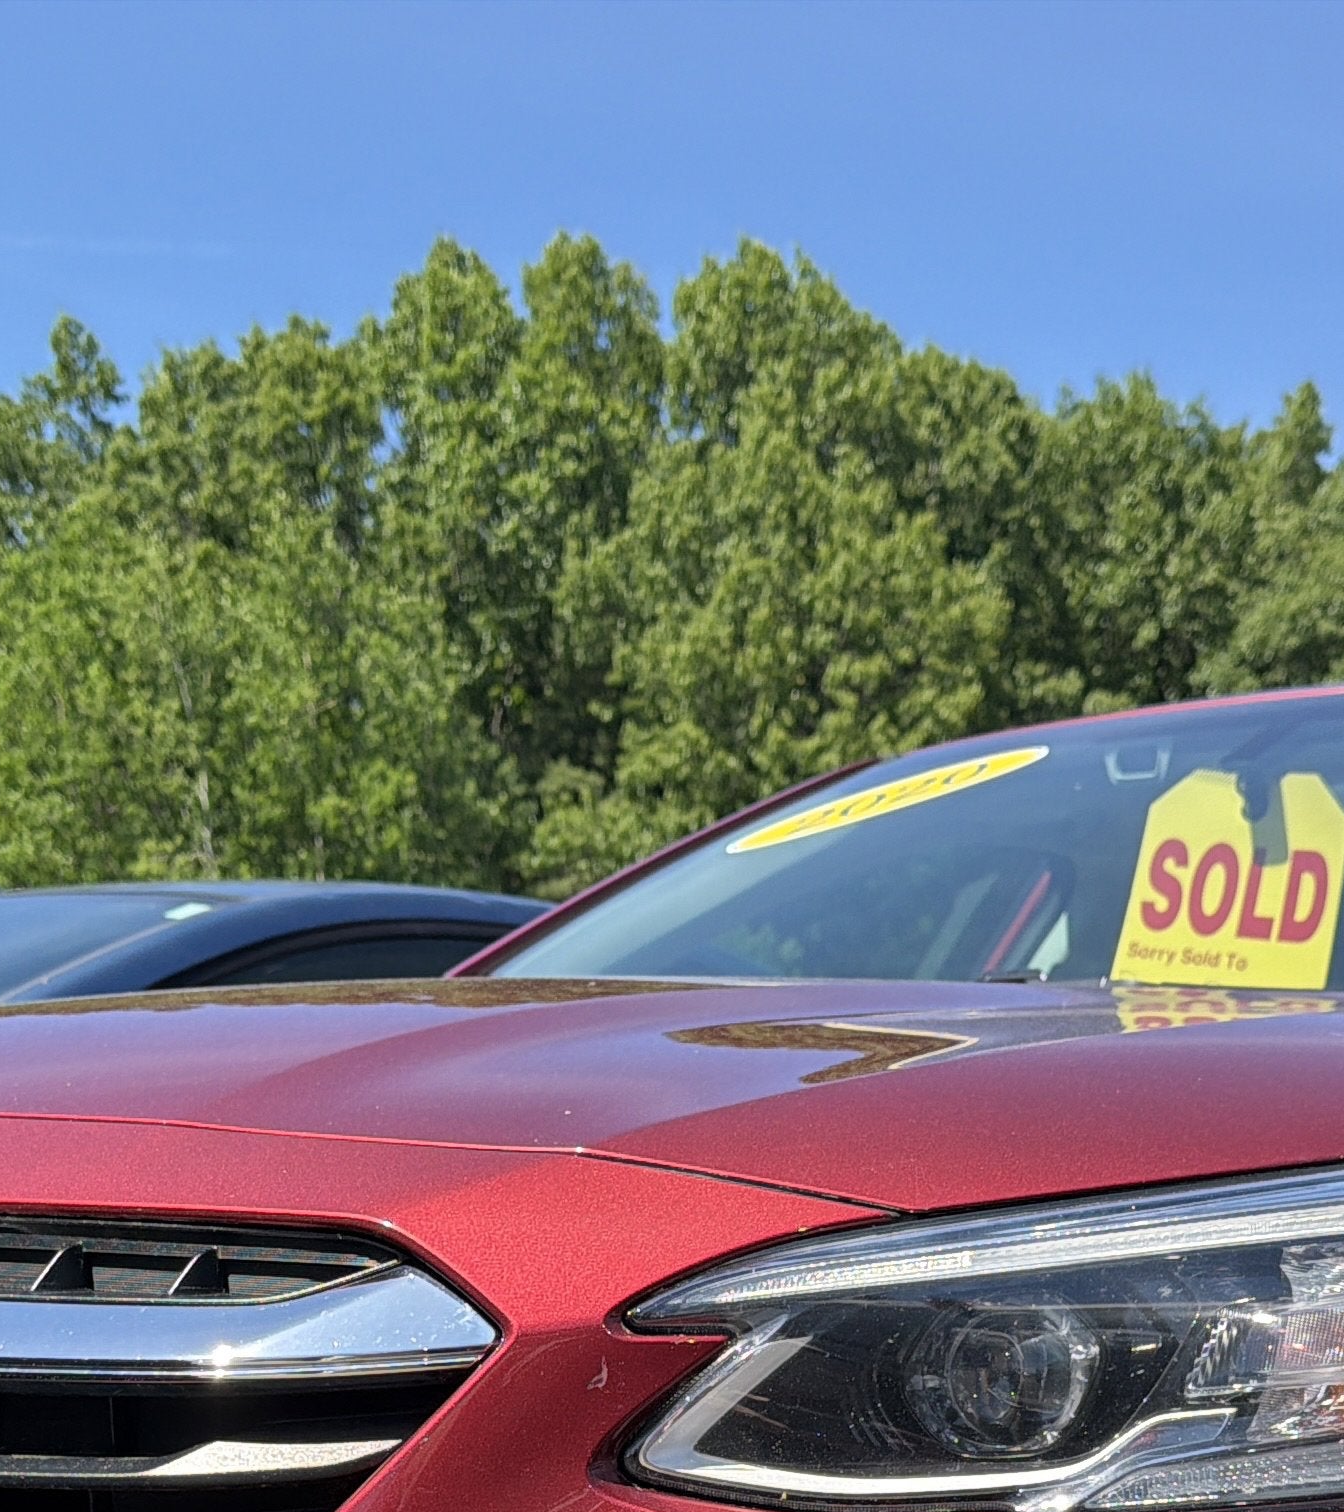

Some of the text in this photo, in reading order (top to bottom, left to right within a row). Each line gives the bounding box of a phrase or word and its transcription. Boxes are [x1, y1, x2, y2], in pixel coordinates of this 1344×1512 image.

[1140, 838, 1329, 943] SOLD
[1127, 942, 1249, 972] Sorry Sold To
